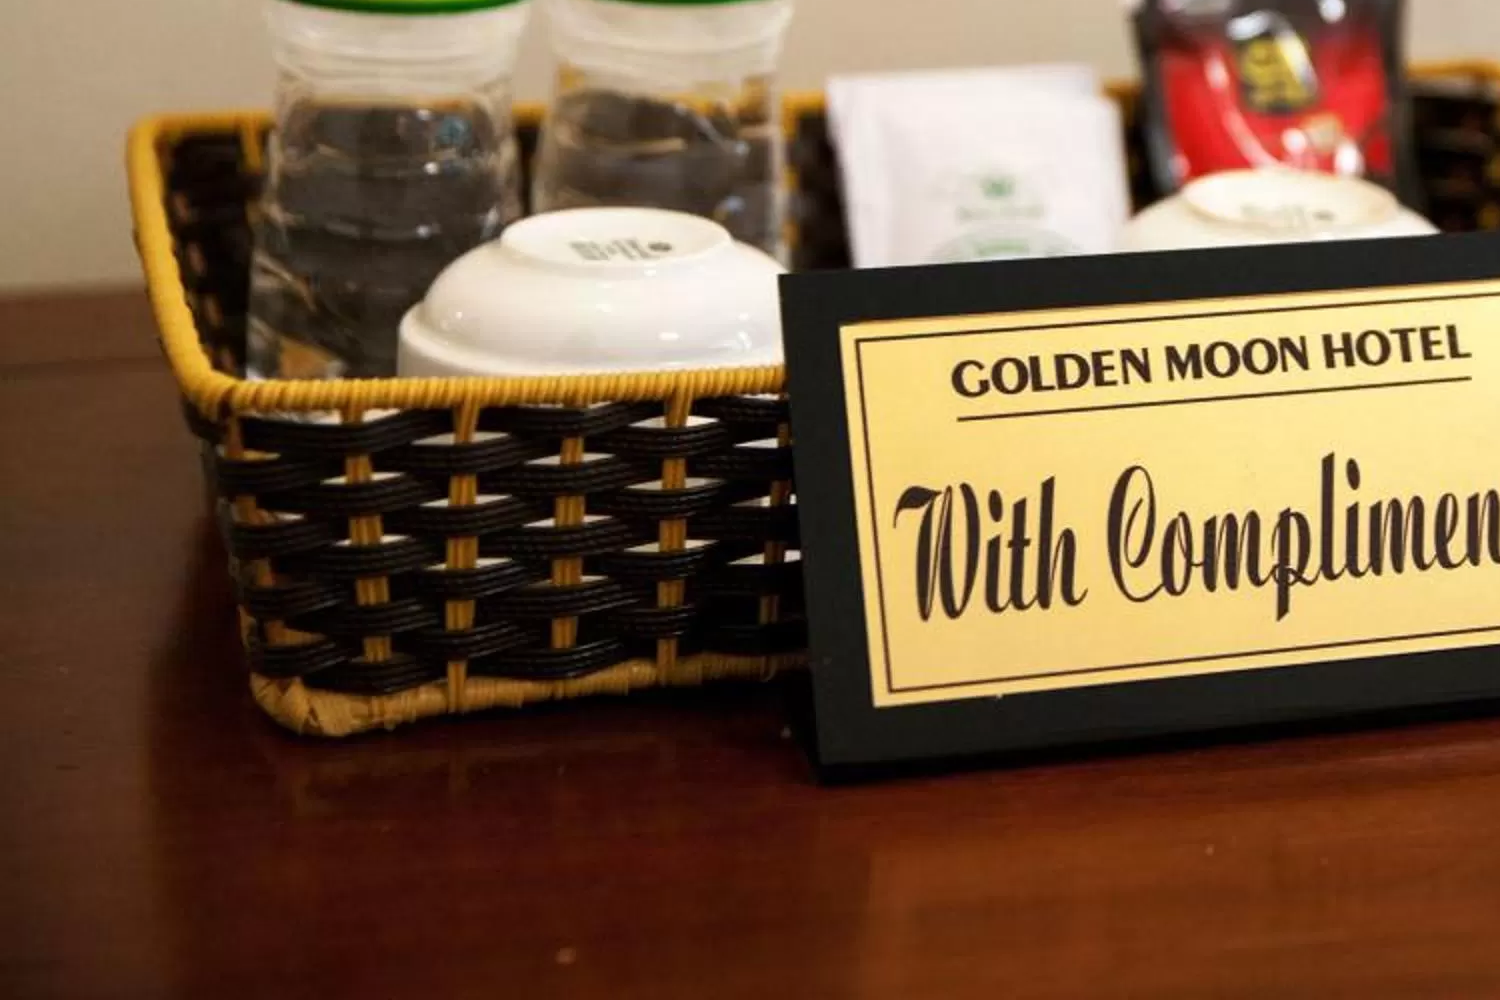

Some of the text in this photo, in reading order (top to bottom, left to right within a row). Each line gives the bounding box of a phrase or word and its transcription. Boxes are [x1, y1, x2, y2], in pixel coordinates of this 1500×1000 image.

[951, 324, 1473, 399] GOLDEN MOON HOTEL
[892, 475, 1089, 622] With
